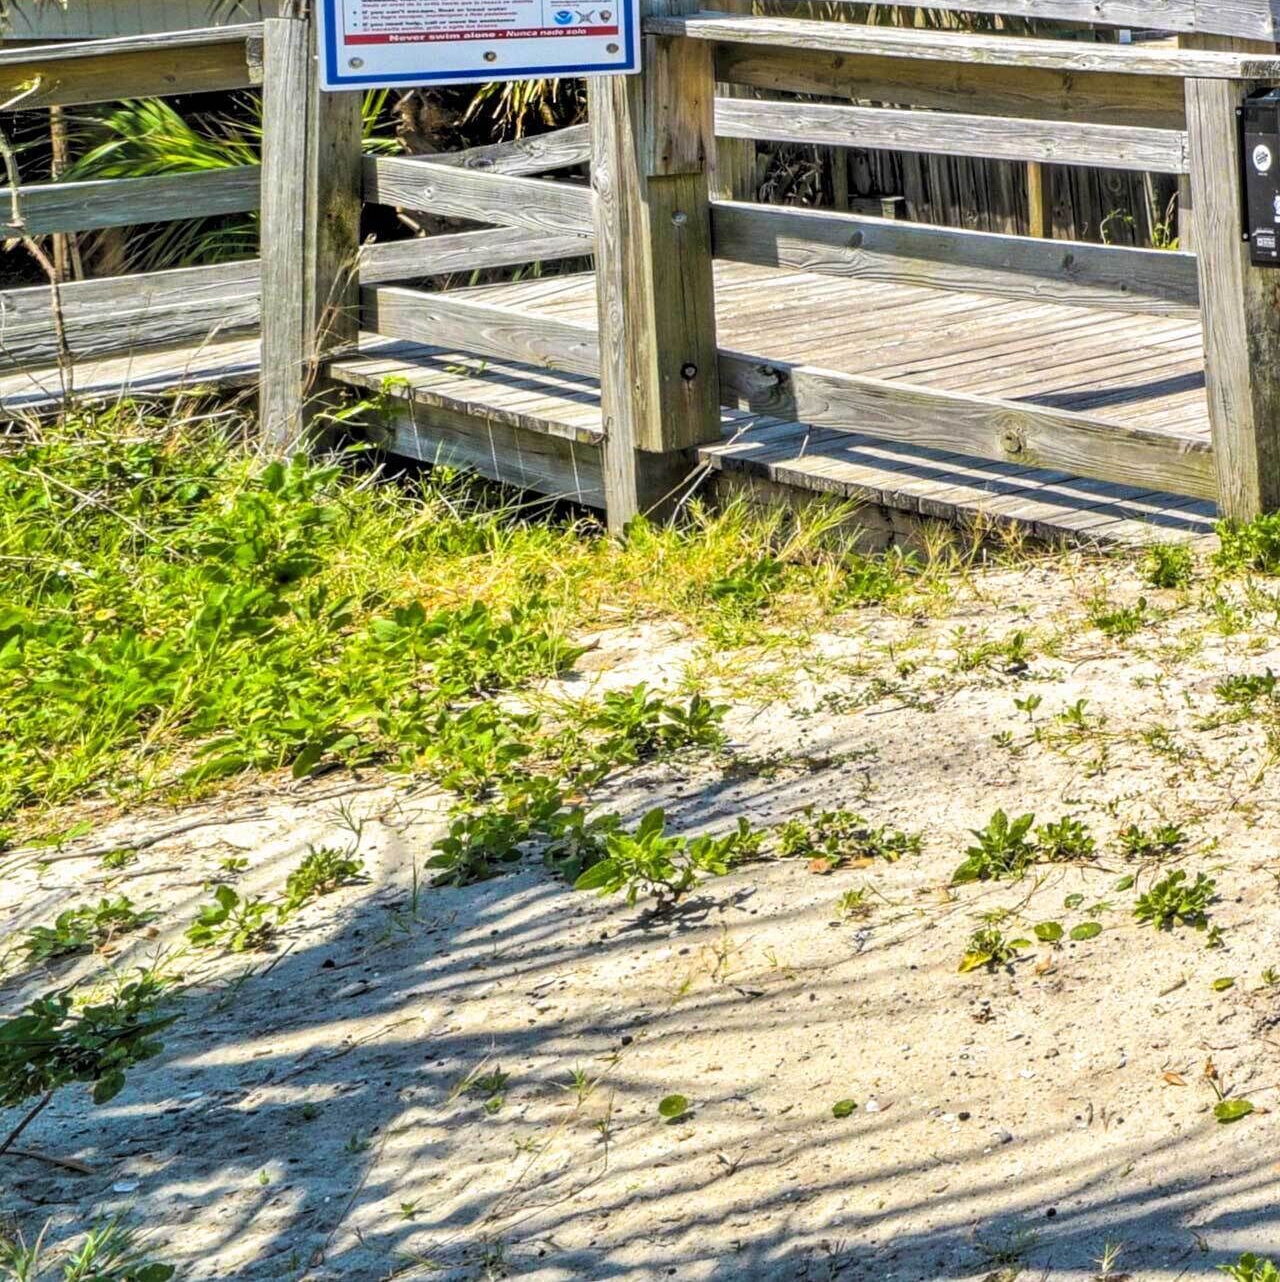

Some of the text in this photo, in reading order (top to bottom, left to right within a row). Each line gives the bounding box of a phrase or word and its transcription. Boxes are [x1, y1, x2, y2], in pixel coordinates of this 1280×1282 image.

[389, 34, 427, 42] Never
[429, 33, 461, 41] swim
[506, 30, 537, 38] Nunca
[566, 28, 587, 36] solo
